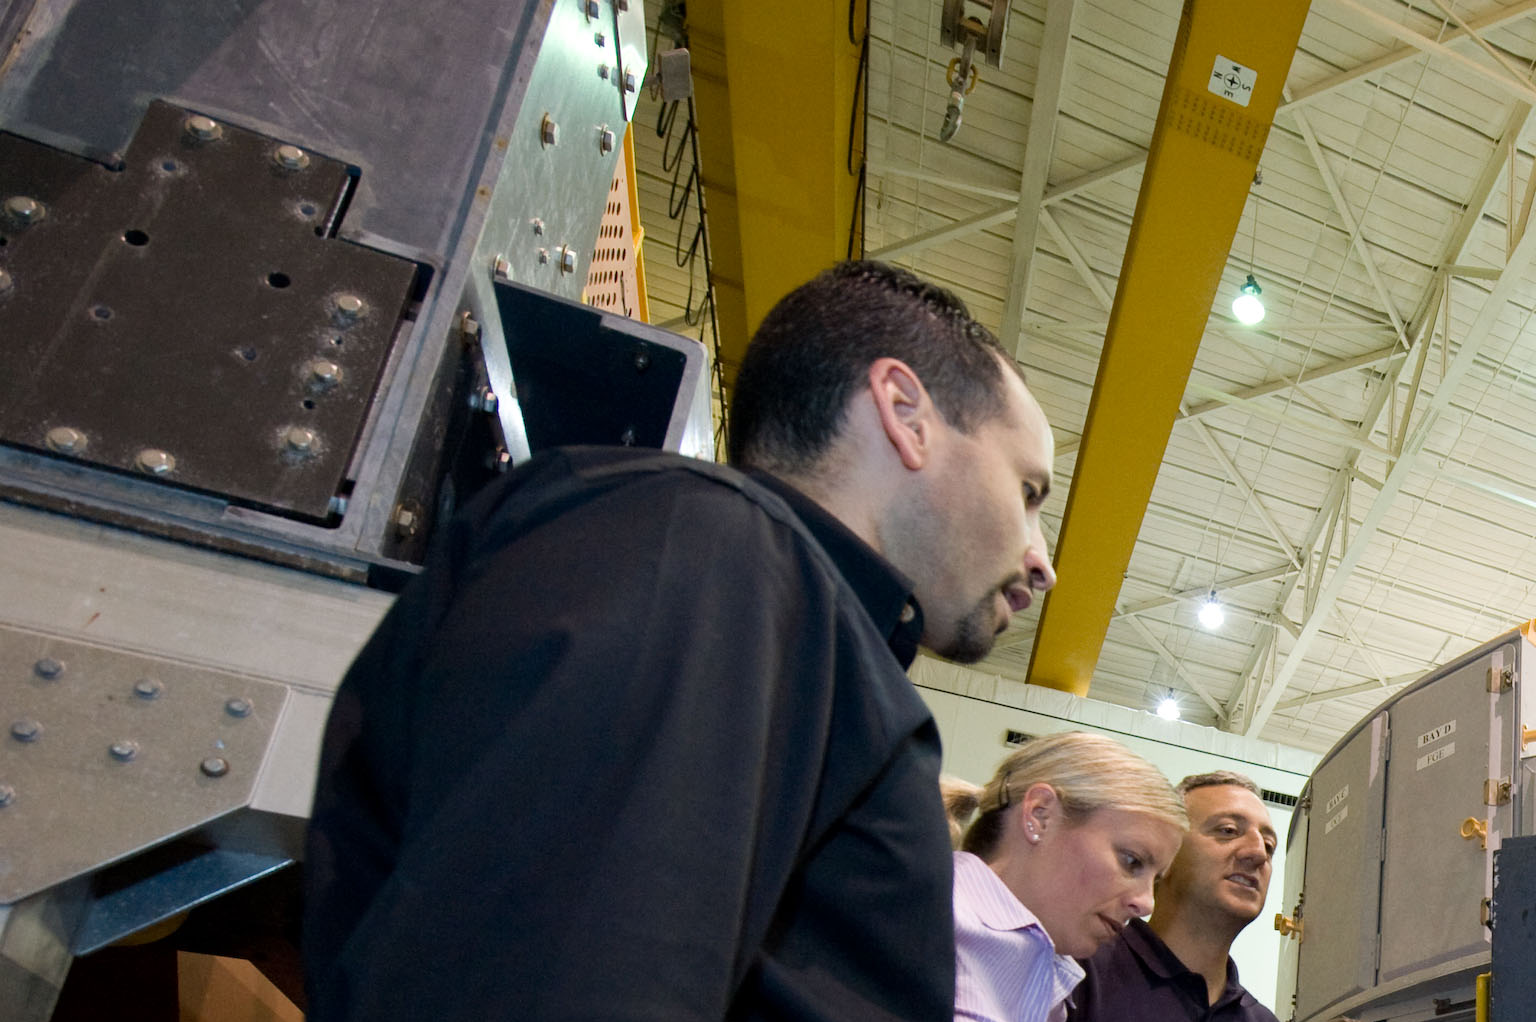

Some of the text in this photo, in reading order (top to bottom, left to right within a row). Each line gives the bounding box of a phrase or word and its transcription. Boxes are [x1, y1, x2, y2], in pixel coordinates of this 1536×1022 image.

[1242, 84, 1251, 92] S
[1224, 89, 1234, 98] E
[1422, 724, 1451, 744] BAY D
